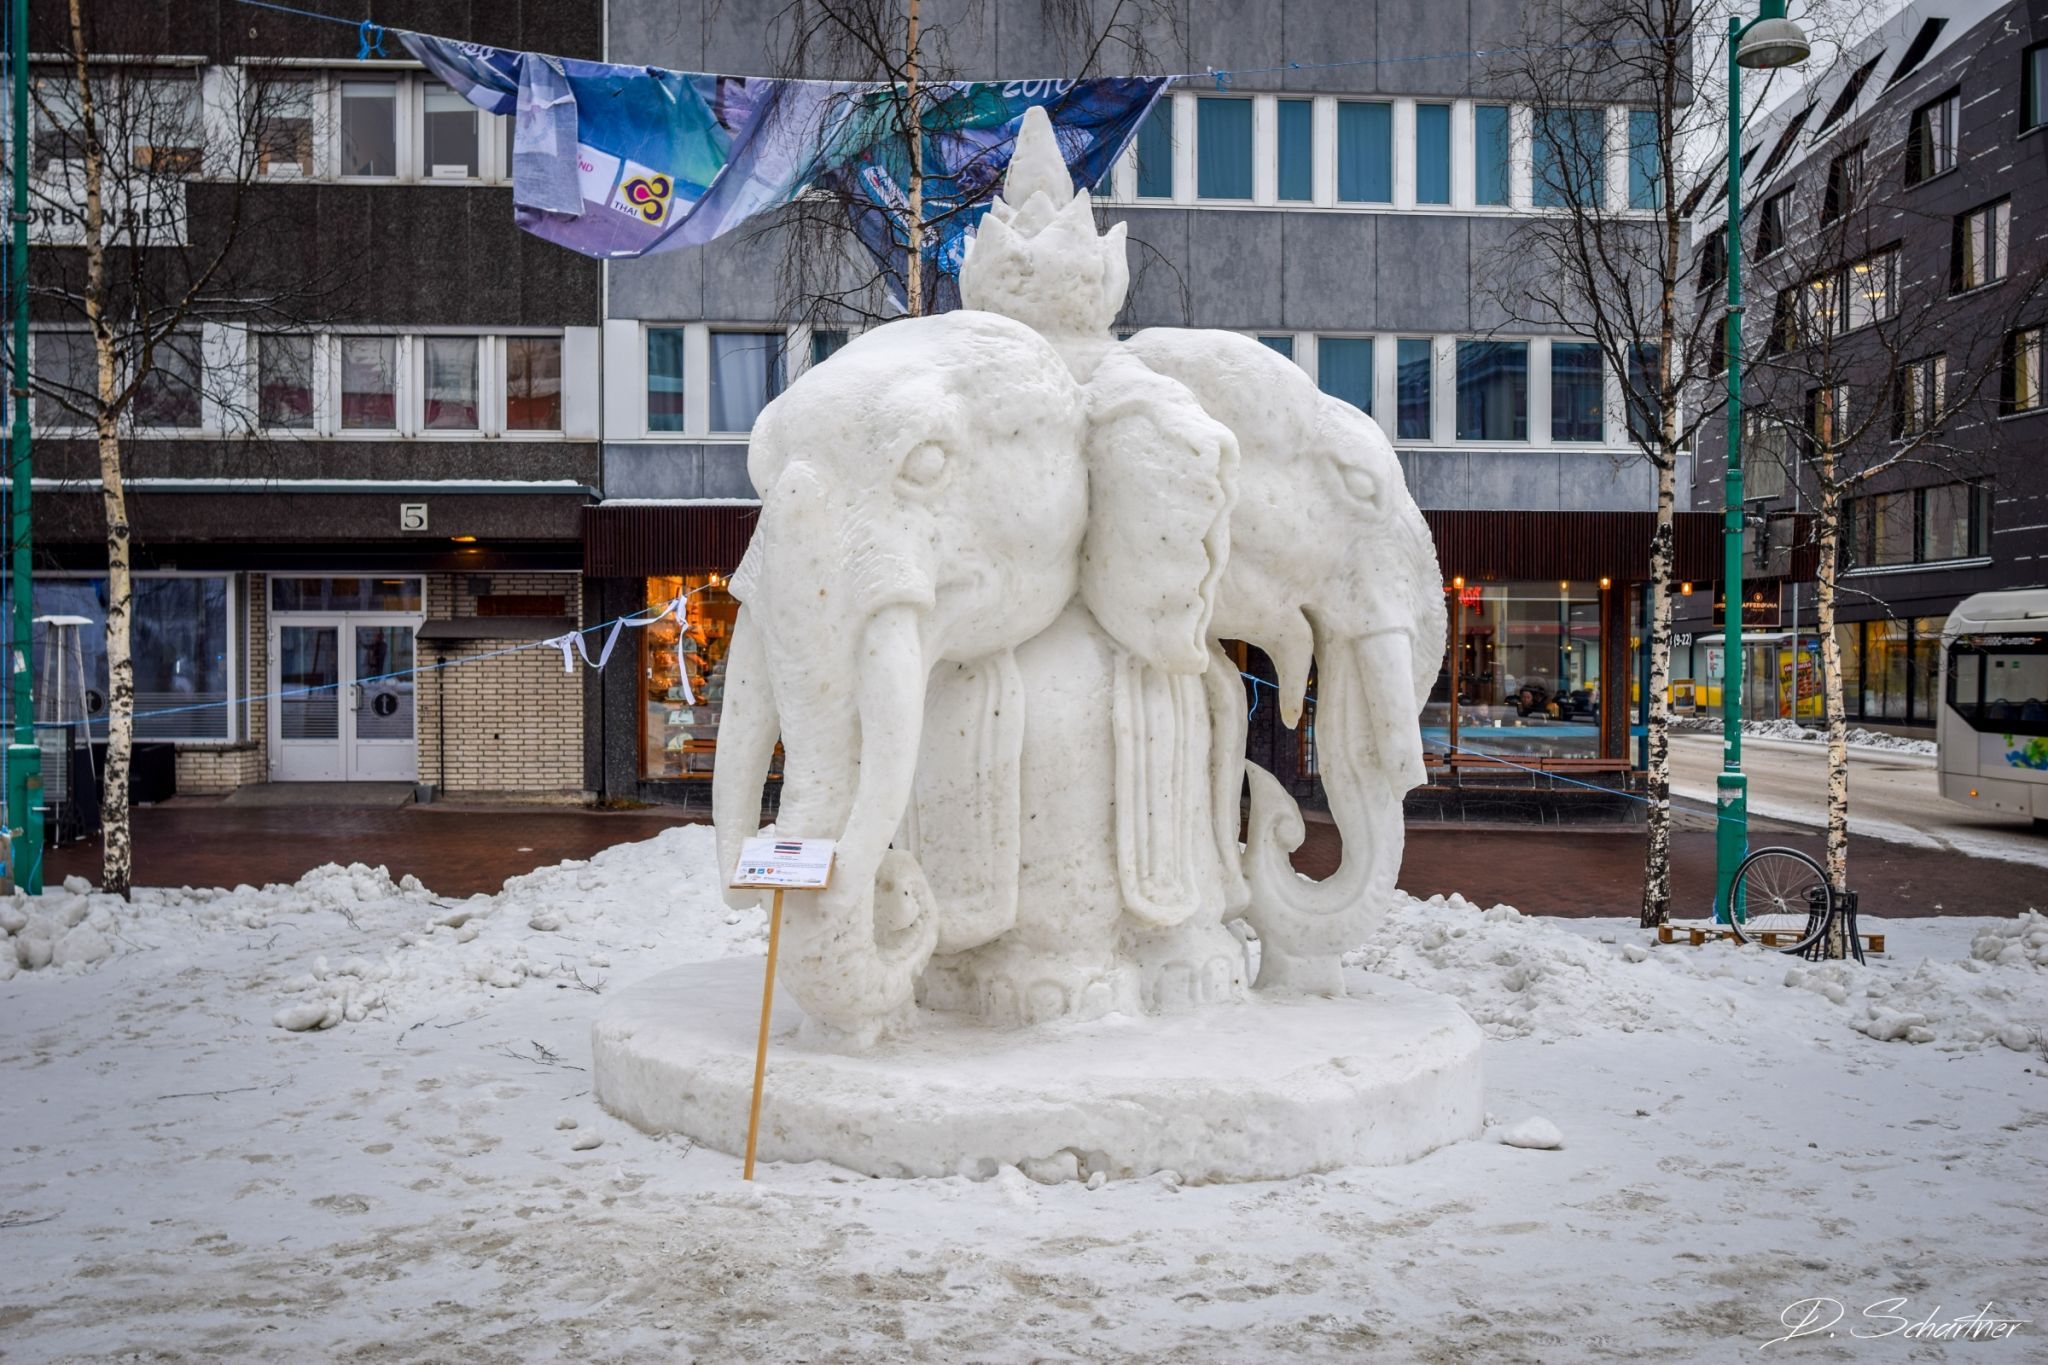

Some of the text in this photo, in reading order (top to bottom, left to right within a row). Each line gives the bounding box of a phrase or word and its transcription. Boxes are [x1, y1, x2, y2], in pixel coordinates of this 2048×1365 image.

[615, 202, 638, 216] THAI
[404, 506, 425, 529] 5
[381, 695, 390, 714] t
